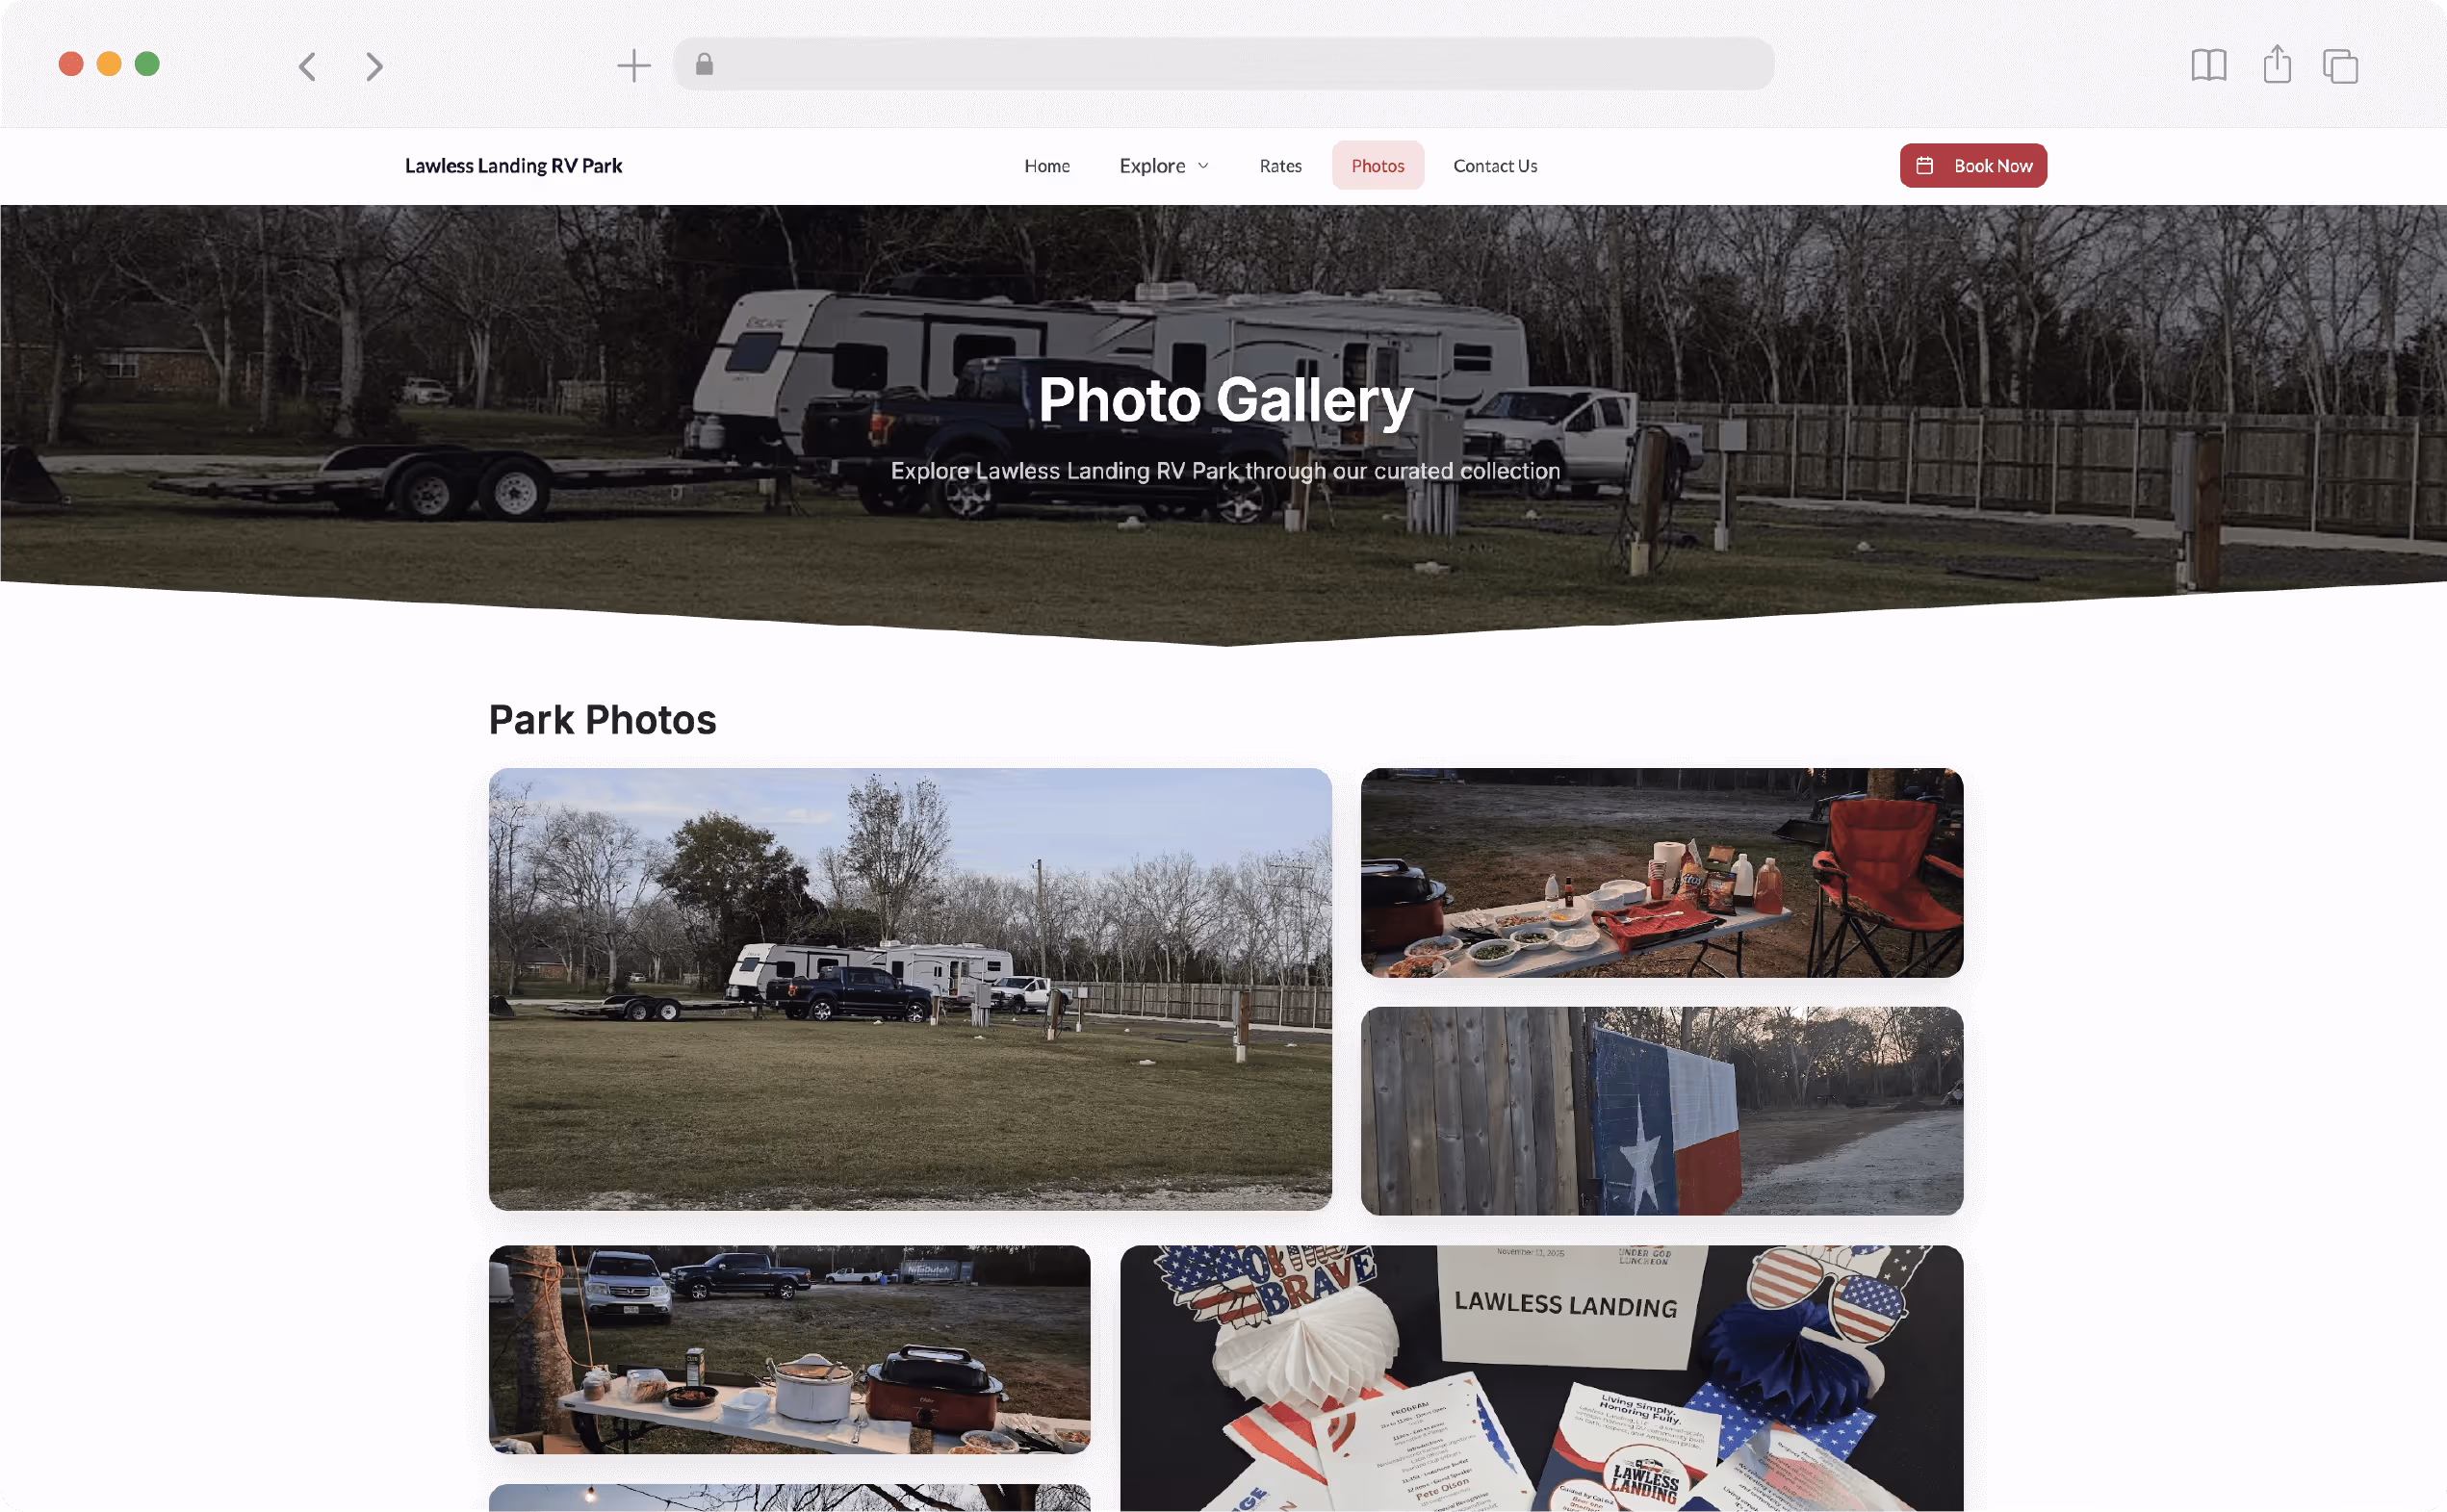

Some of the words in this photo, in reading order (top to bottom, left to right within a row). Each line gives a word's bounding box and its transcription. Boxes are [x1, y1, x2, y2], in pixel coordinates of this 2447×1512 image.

[406, 158, 474, 173] Lawless
[479, 158, 547, 177] Landing
[553, 158, 579, 173] RV
[583, 158, 623, 173] Park
[1025, 159, 1070, 173] Home
[1120, 158, 1186, 177] Explore
[1260, 159, 1302, 173] Rates
[1352, 158, 1405, 173] Photos
[1454, 159, 1515, 173] Contact
[1518, 159, 1538, 173] Us
[1955, 158, 1995, 173] Book
[1998, 158, 2034, 173] Now
[1042, 376, 1201, 423] Photo
[1217, 376, 1415, 434] Gallery
[892, 461, 970, 484] Explore
[977, 461, 1060, 479] Lawless
[1069, 461, 1149, 485] Landing
[1157, 461, 1186, 479] RV
[1193, 461, 1240, 479] Park
[1245, 461, 1327, 485] through
[1333, 466, 1368, 479] our
[1375, 461, 1454, 480] curated
[1460, 461, 1560, 479] collection
[490, 704, 575, 735] Park
[587, 704, 716, 735] Photos
[1497, 1247, 1533, 1256] November
[1546, 1249, 1565, 1258] 2025
[1619, 1248, 1649, 1257] UNDER
[1619, 1257, 1669, 1266] LUNCHEON
[1255, 1247, 1375, 1317] BRAVE
[1455, 1291, 1563, 1315] LAWLESS
[1569, 1295, 1678, 1319] LANDING
[1390, 1401, 1430, 1417] PROGRAM
[1599, 1401, 1650, 1420] Honoring
[1652, 1413, 1683, 1426] Fully.
[1602, 1394, 1633, 1409] Living
[1636, 1401, 1677, 1417] Simply.
[1613, 1464, 1680, 1492] LAWLESS
[1416, 1488, 1440, 1501] Pete
[1441, 1478, 1470, 1492] Olson
[1559, 1485, 1584, 1497] Guided
[1610, 1477, 1677, 1505] LANDING
